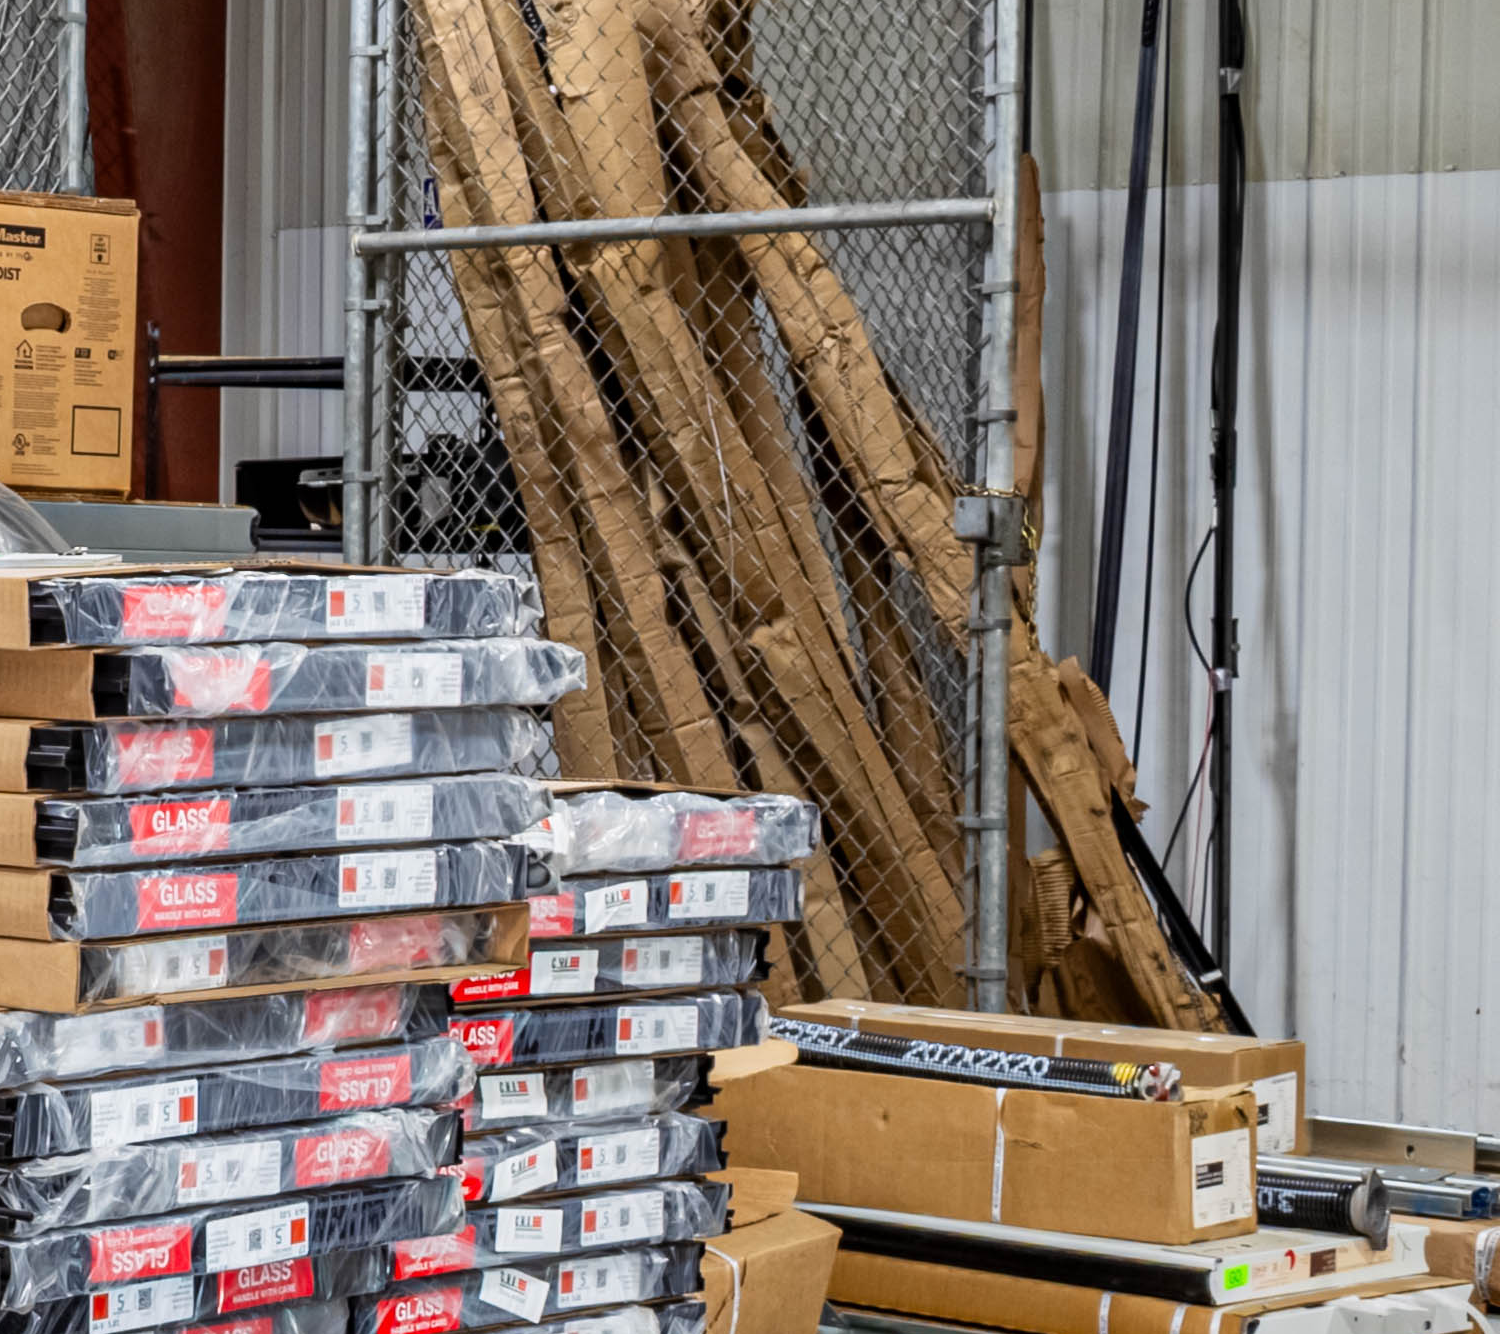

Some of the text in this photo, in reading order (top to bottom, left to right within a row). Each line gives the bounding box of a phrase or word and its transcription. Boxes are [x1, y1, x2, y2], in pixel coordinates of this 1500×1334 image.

[152, 808, 209, 832] GLASS
[159, 880, 217, 905] GLASS
[111, 1248, 169, 1274] GLASS
[238, 1261, 291, 1288] GLASS
[233, 1284, 297, 1305] HANDLE WITH CARE
[395, 1296, 445, 1322] GLASS
